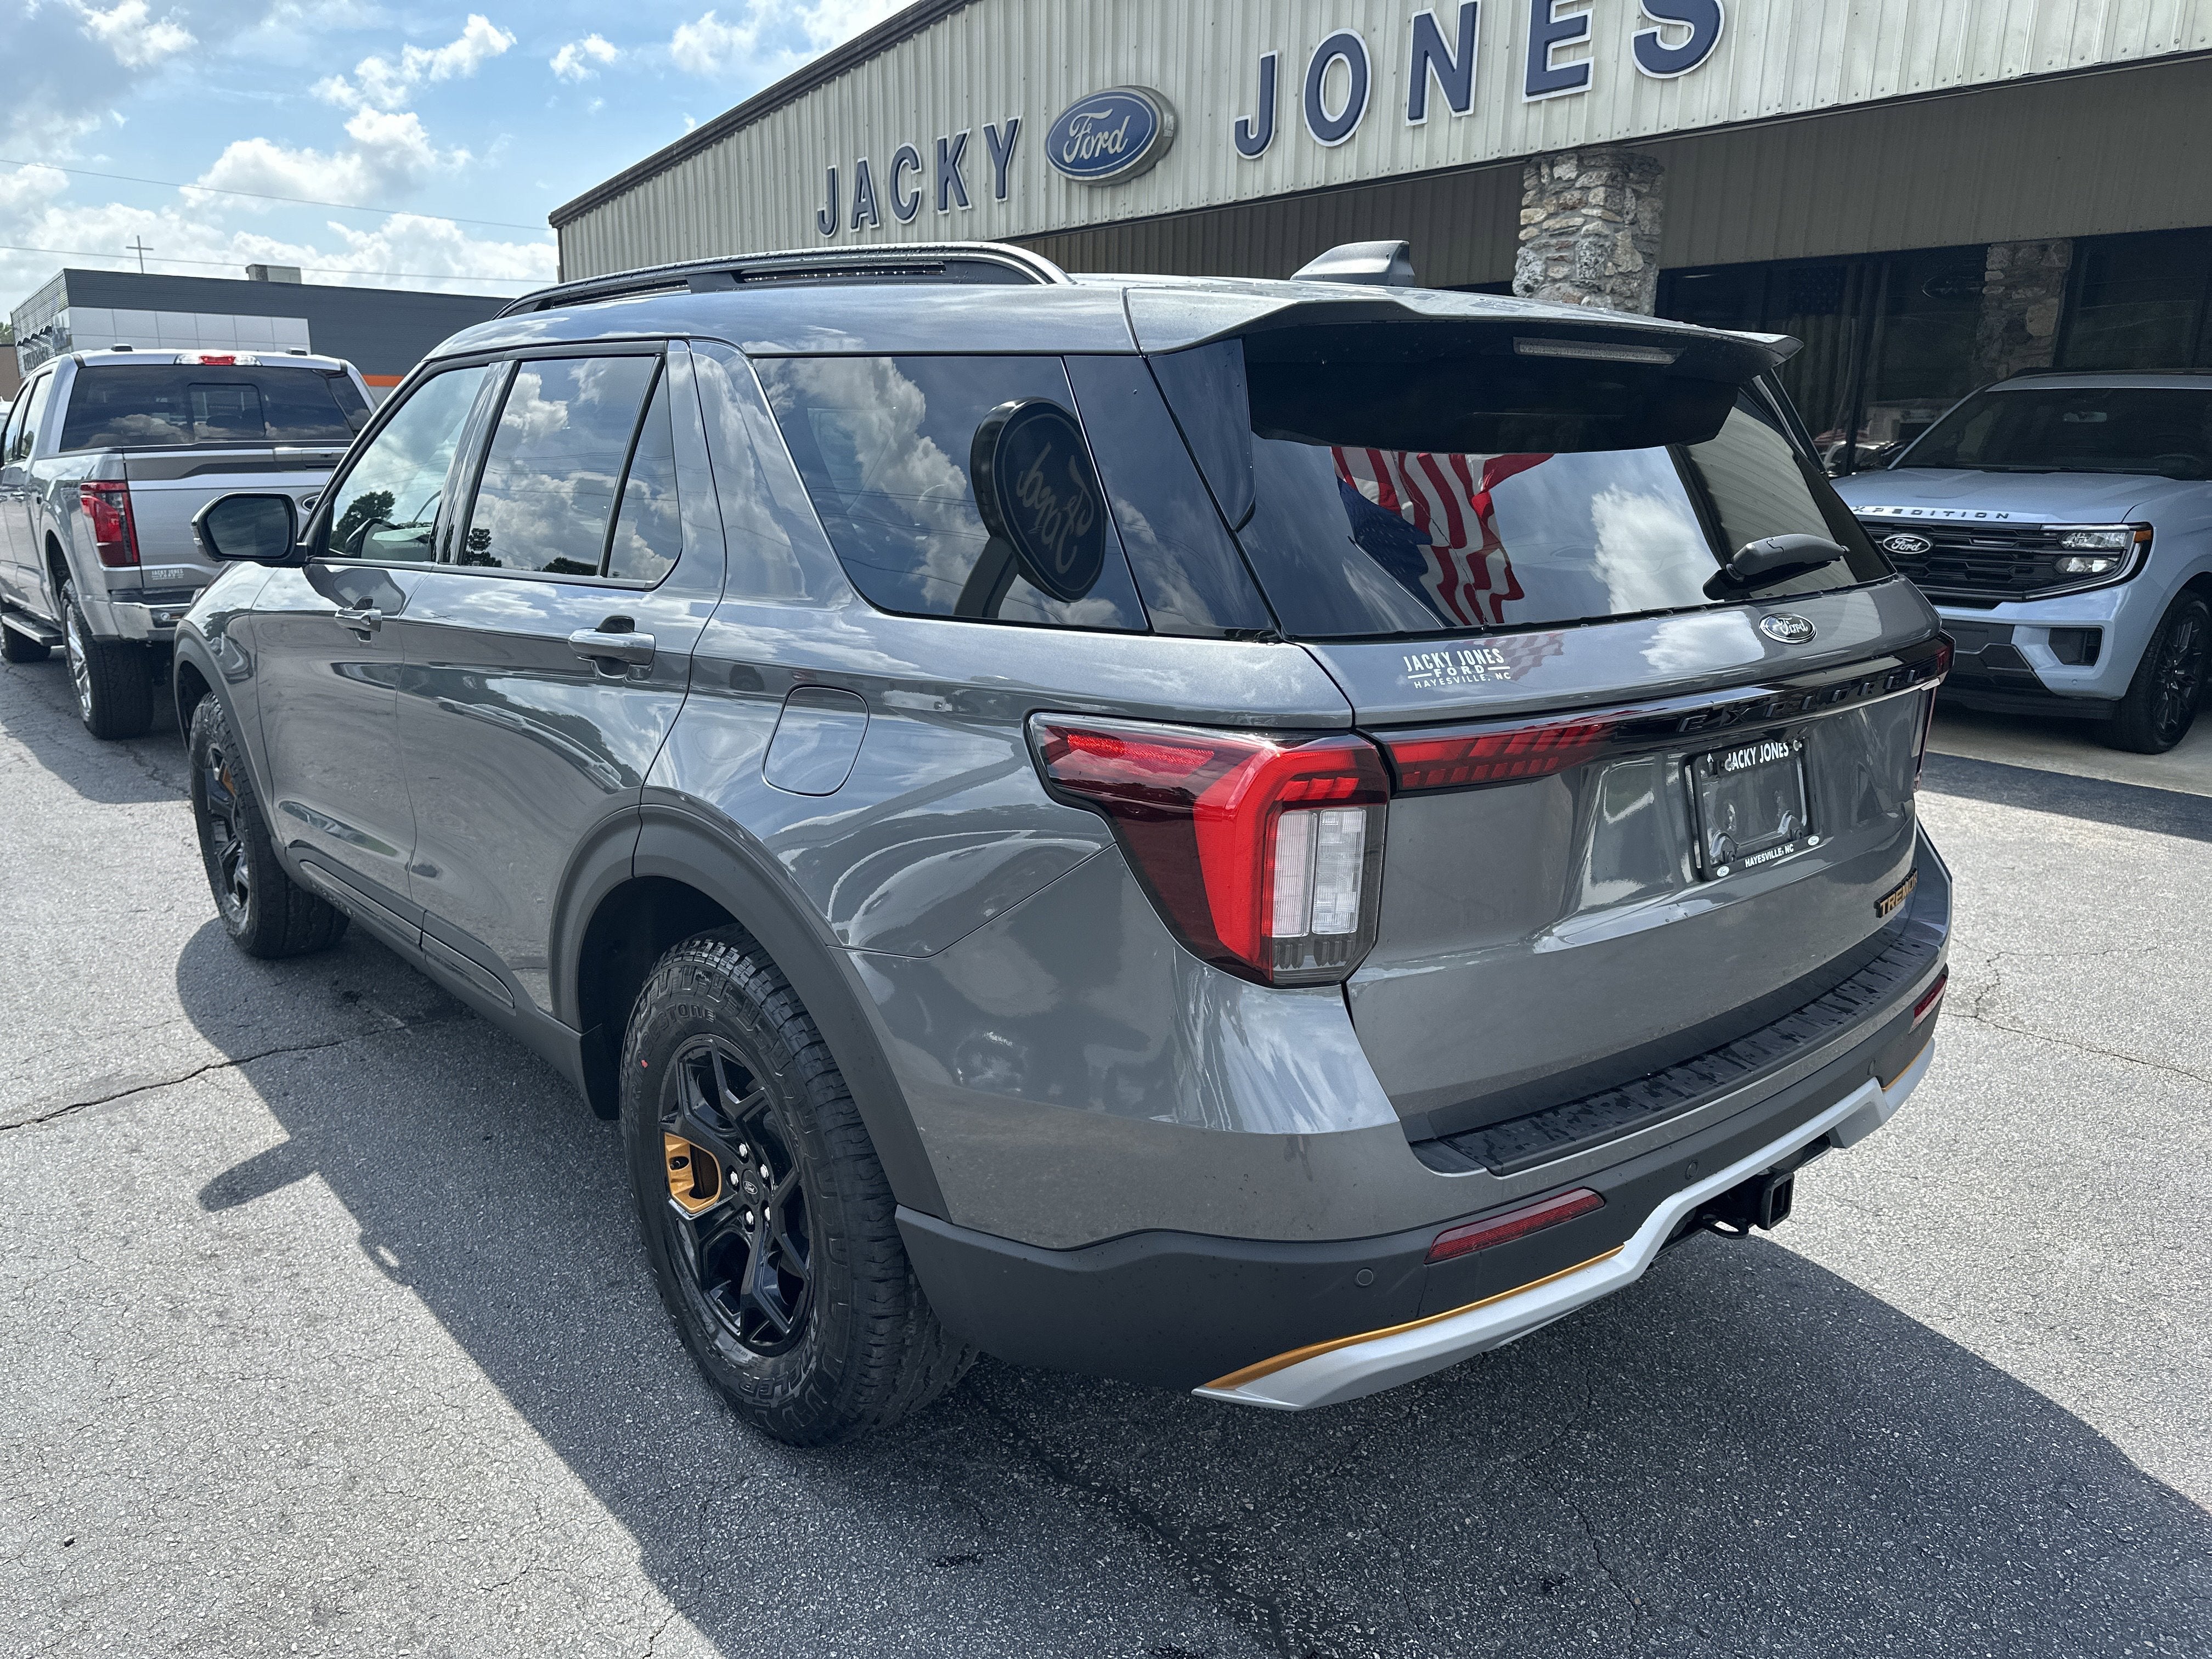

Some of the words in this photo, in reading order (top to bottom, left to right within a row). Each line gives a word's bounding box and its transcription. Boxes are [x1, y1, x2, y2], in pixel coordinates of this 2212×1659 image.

[817, 116, 1022, 238] JACKY
[1063, 109, 1131, 163] Ford
[1234, 0, 1725, 159] JONES
[1852, 506, 2009, 519] XPEDITION
[1891, 537, 1922, 552] Ford
[1776, 617, 1809, 635] Ford
[1403, 651, 1453, 672] JACKY
[1457, 648, 1504, 666] JONES
[1433, 664, 1485, 678] FORD
[1494, 672, 1511, 680] NC
[1759, 742, 1789, 764] JONES
[1785, 843, 1794, 853] NC
[1880, 870, 1917, 916] TREMOR
